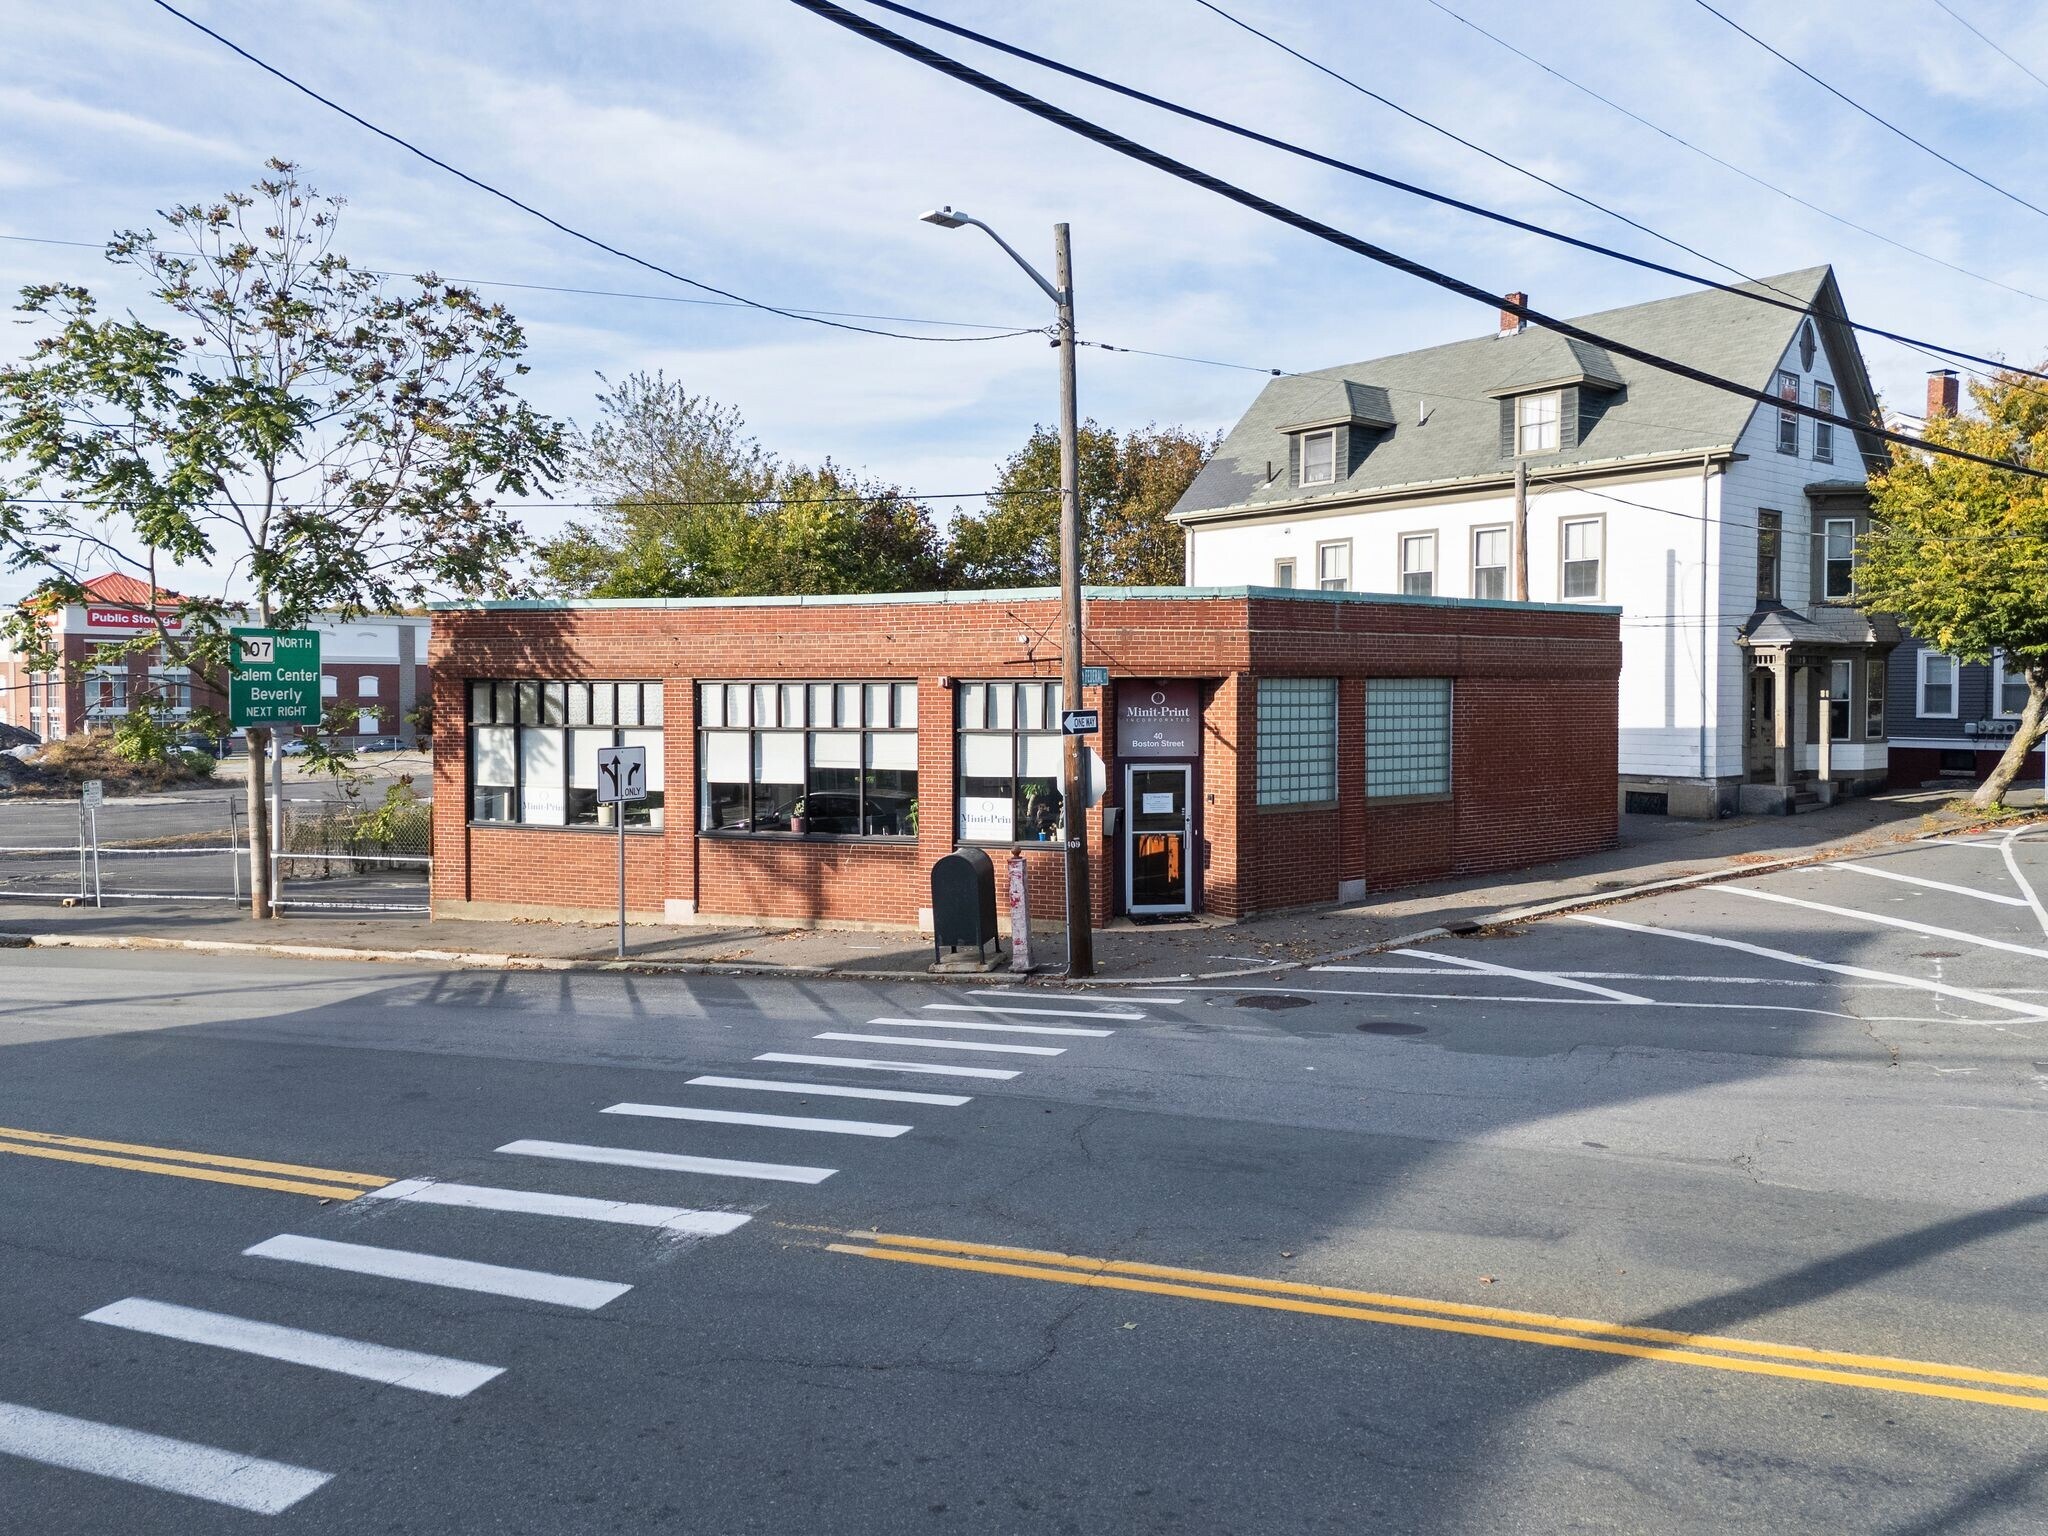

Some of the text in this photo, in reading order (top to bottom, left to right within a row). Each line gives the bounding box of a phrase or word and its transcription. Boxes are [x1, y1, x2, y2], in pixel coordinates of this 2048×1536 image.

[91, 612, 177, 626] Public Storge
[246, 636, 312, 657] 07 NORTH
[276, 668, 318, 682] Center
[251, 687, 303, 704] Beverly
[246, 706, 307, 717] NEXT RIGHT
[1127, 706, 1190, 717] Minit-Print
[1074, 717, 1096, 728] ONE WAY
[1153, 732, 1163, 740] 40
[1132, 740, 1185, 748] Boston Street
[624, 787, 642, 797] ONLY
[961, 813, 1012, 824] Minit-Prin
